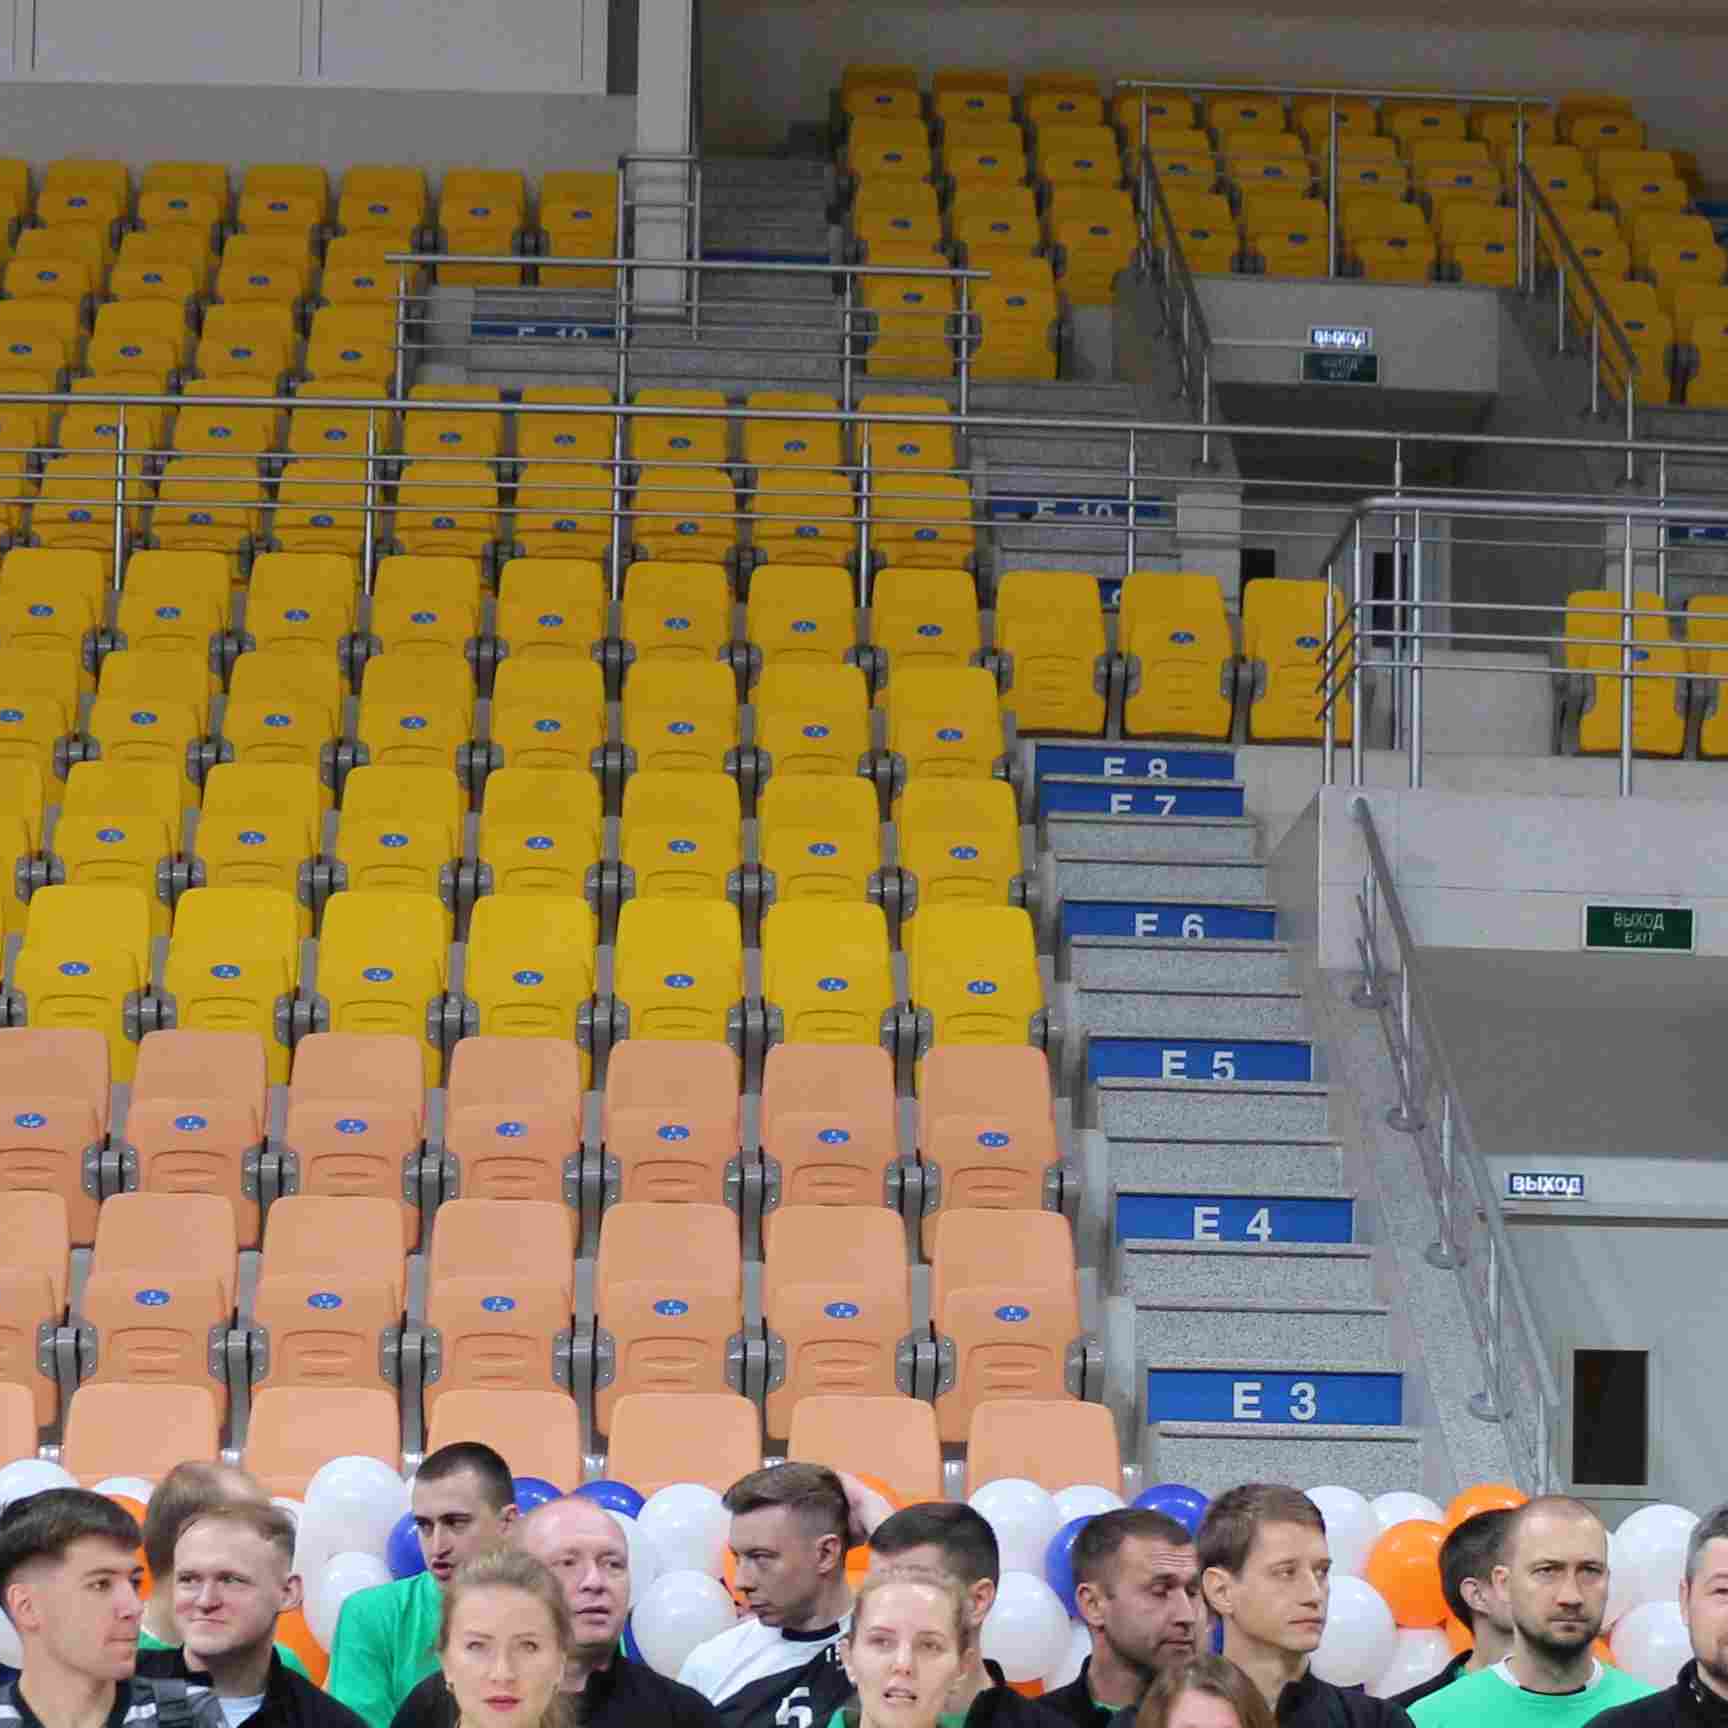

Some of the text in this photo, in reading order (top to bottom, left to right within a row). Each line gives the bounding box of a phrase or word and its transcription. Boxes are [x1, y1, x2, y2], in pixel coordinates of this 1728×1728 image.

[1182, 913, 1204, 939] 6
[1613, 911, 1664, 931] ВЫХОД
[1624, 931, 1654, 944] EXIT
[1162, 1050, 1234, 1080] E 5
[1512, 1175, 1581, 1193] ВЫХОД
[1193, 1206, 1272, 1242] E 4
[1233, 1382, 1316, 1421] E 3
